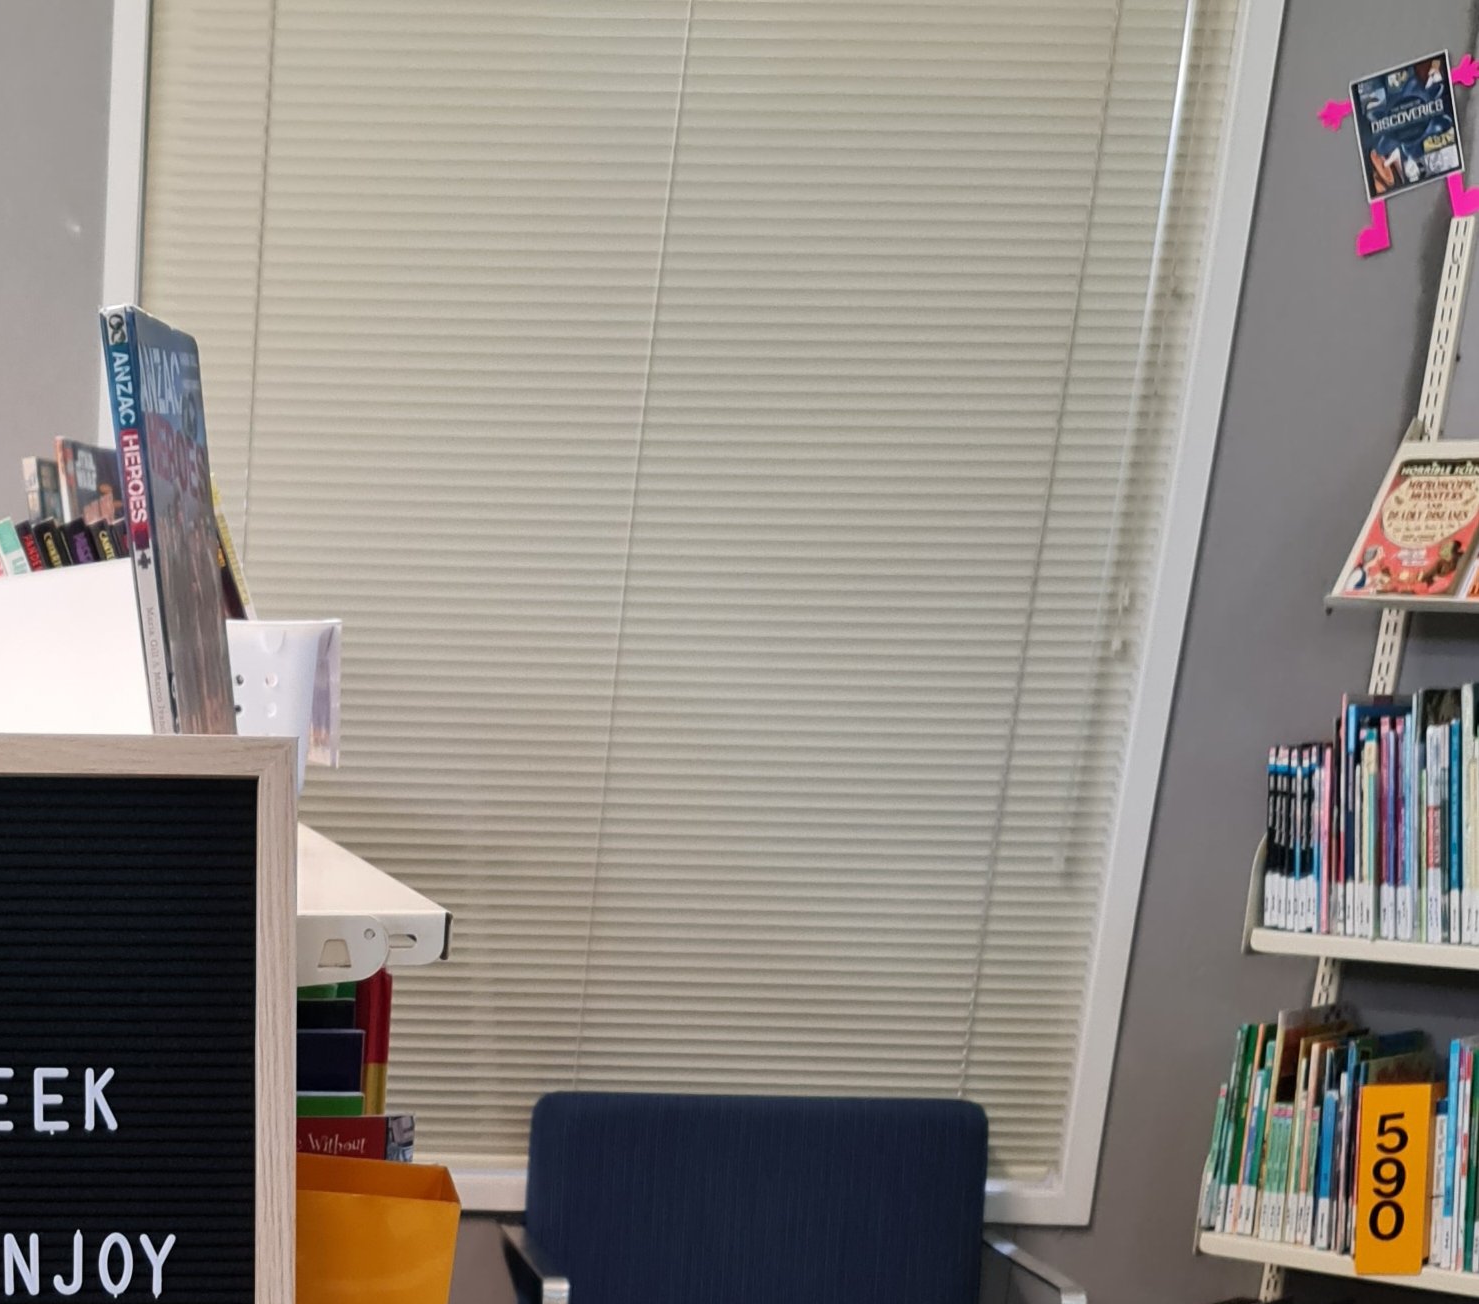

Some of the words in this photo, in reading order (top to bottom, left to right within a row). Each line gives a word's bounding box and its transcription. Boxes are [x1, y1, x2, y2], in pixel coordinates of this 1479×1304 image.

[112, 351, 136, 425] ANZAC
[122, 433, 148, 524] HEROES
[308, 1132, 366, 1156] Without
